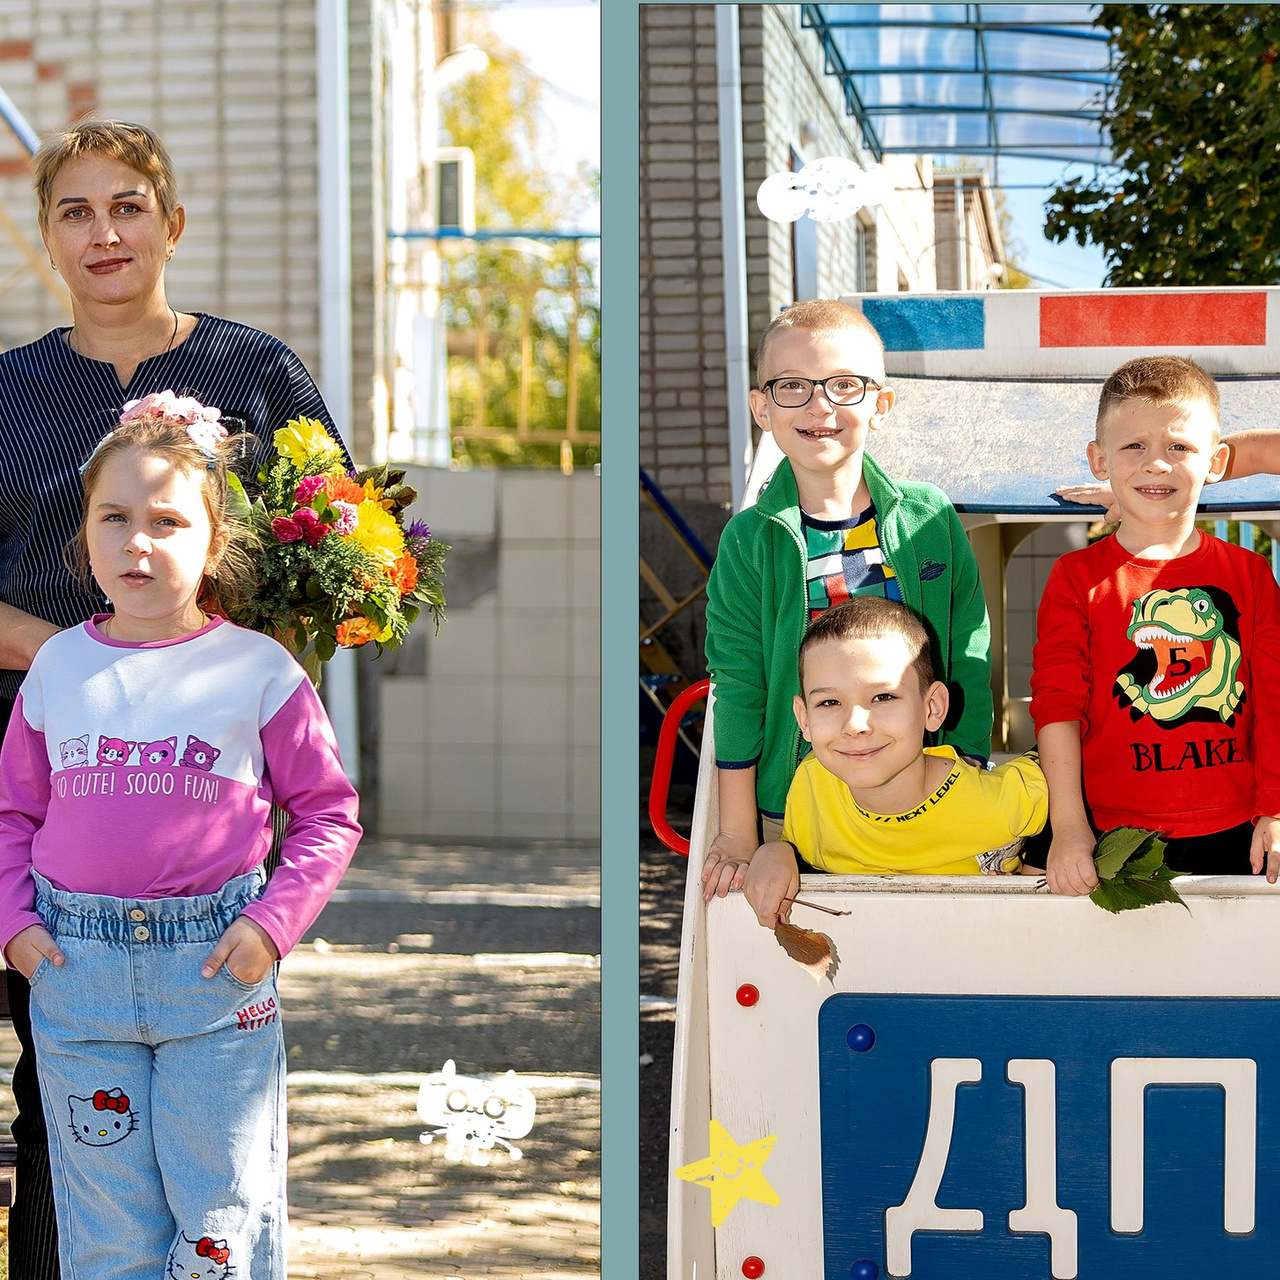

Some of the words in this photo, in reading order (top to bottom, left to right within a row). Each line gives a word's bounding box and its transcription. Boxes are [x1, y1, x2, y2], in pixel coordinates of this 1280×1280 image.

[1169, 647, 1192, 677] 5
[1130, 737, 1244, 772] BLAKE
[72, 772, 115, 798] CUTE!
[124, 772, 175, 796] SOOO
[184, 774, 220, 805] FUN!
[896, 803, 928, 823] NEXT
[930, 770, 961, 806] LEVEL
[236, 996, 277, 1023] HELLO
